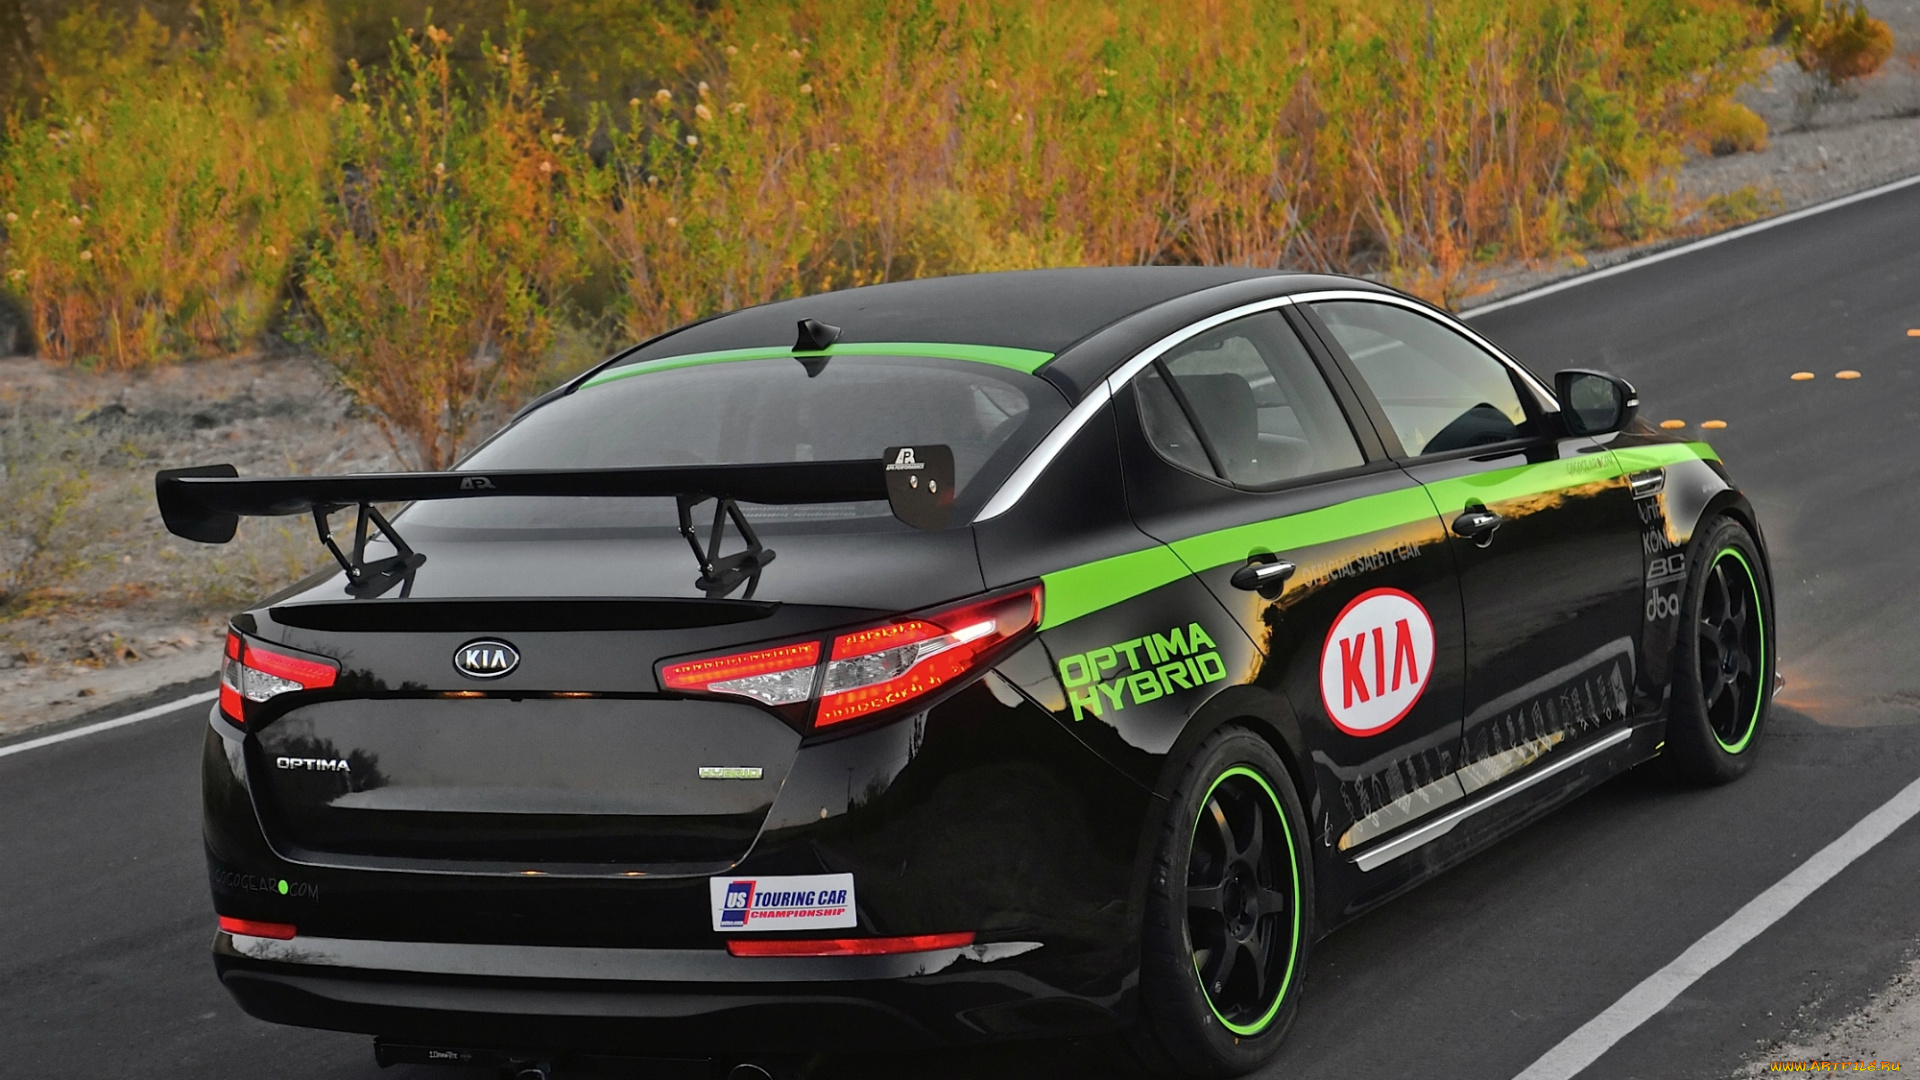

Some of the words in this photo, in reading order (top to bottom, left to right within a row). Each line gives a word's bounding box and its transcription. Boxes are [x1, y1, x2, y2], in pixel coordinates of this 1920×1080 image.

[1302, 555, 1357, 587] OFFICIAL
[1356, 545, 1396, 573] SAFETY
[1397, 539, 1422, 562] CAR
[1646, 553, 1686, 580] BC
[1646, 587, 1680, 622] dba
[466, 649, 507, 669] KIA
[1058, 622, 1218, 688] OPTIMA
[1339, 618, 1418, 709] KIA
[1069, 651, 1227, 721] HYBRID
[276, 757, 351, 772] OPTIMA
[699, 767, 762, 779] HYBRID
[727, 891, 748, 909] US
[754, 891, 815, 907] TOURING
[817, 889, 848, 905] CAR
[750, 908, 846, 919] CHAMPIONSHIP
